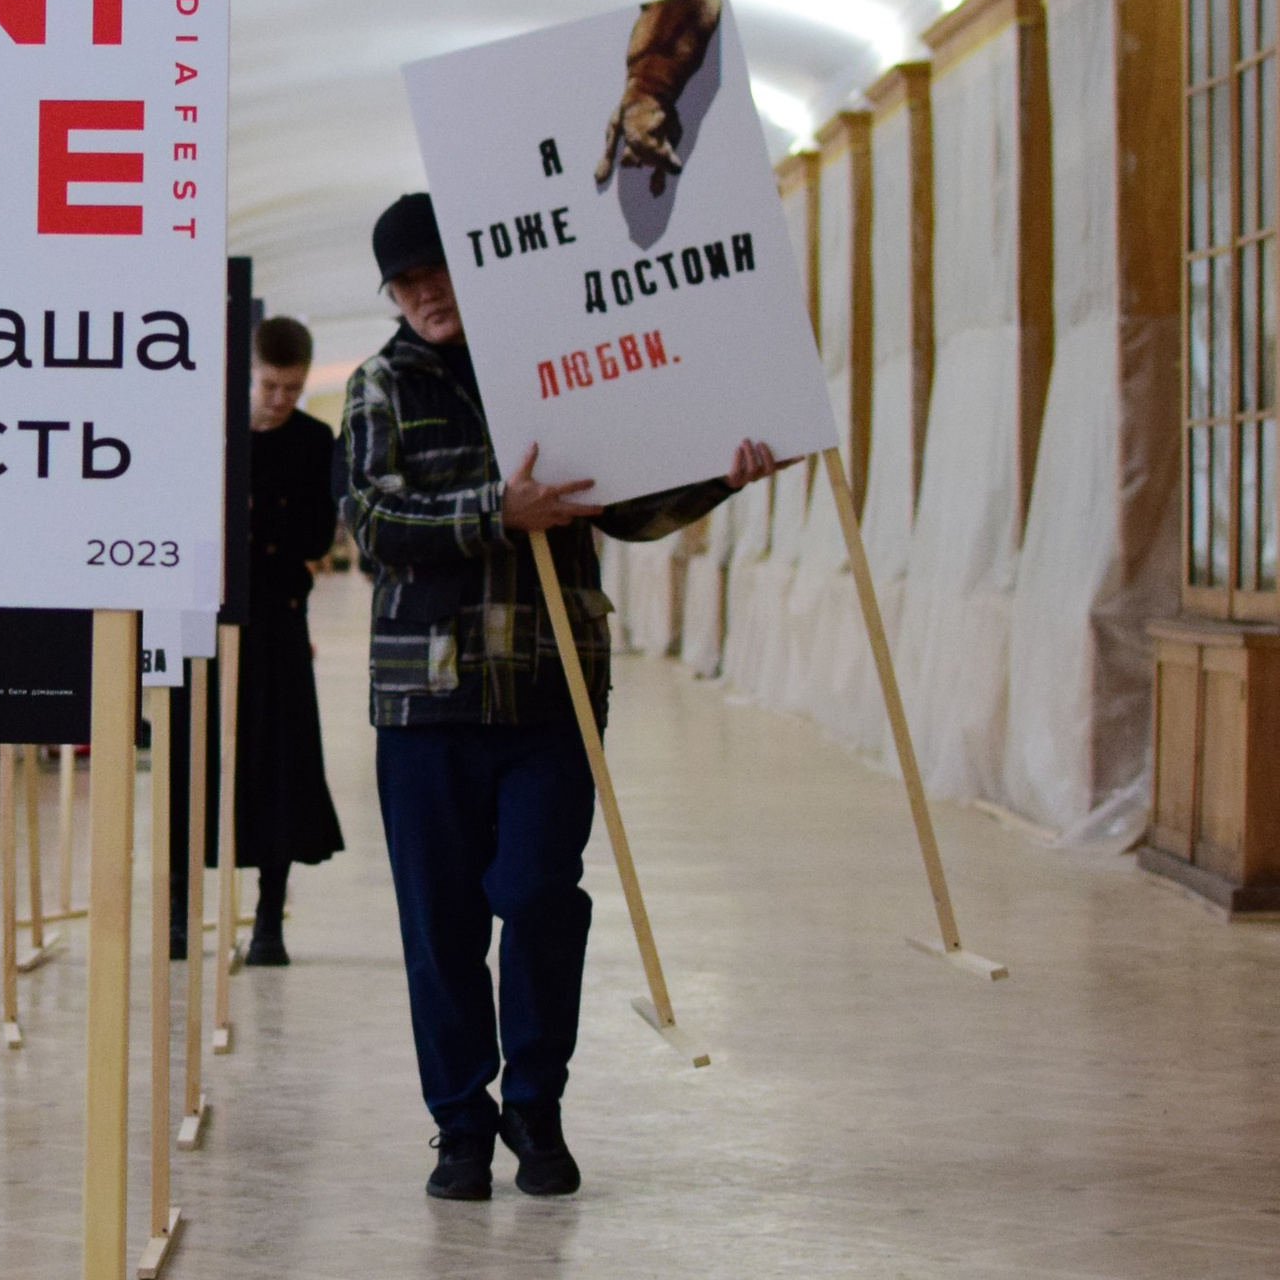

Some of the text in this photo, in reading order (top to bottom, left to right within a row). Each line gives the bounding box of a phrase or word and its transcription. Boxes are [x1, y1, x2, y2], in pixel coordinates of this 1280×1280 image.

[539, 138, 563, 177] Я
[466, 206, 577, 268] ТОЖЕ
[584, 232, 756, 314] ДОСТОИН
[536, 330, 681, 399] ЛЮБВИ.
[86, 538, 181, 568] 2023
